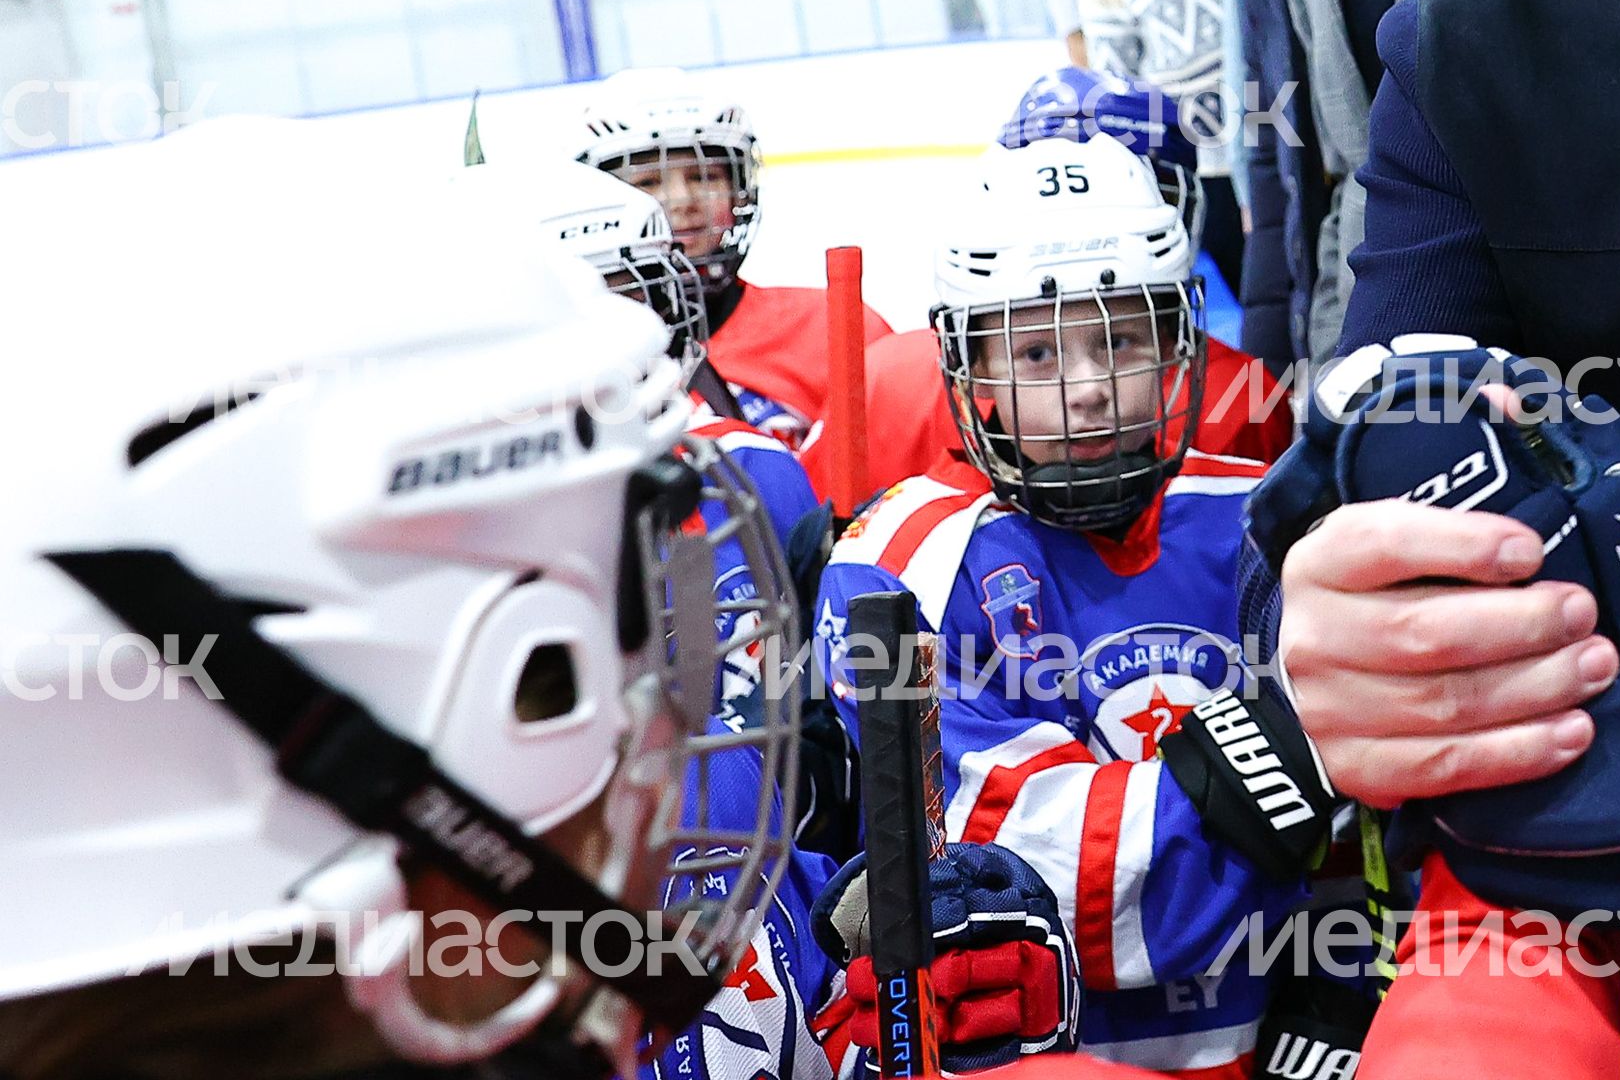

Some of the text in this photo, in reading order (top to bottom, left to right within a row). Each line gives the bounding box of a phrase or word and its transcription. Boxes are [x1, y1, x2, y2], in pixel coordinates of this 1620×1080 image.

[1036, 164, 1090, 198] 35
[559, 220, 620, 240] CCM
[387, 429, 563, 497] BAUER
[1400, 450, 1489, 506] CC
[1089, 644, 1209, 691] АКАДЕМИЯ
[889, 970, 911, 1080] OVERT
